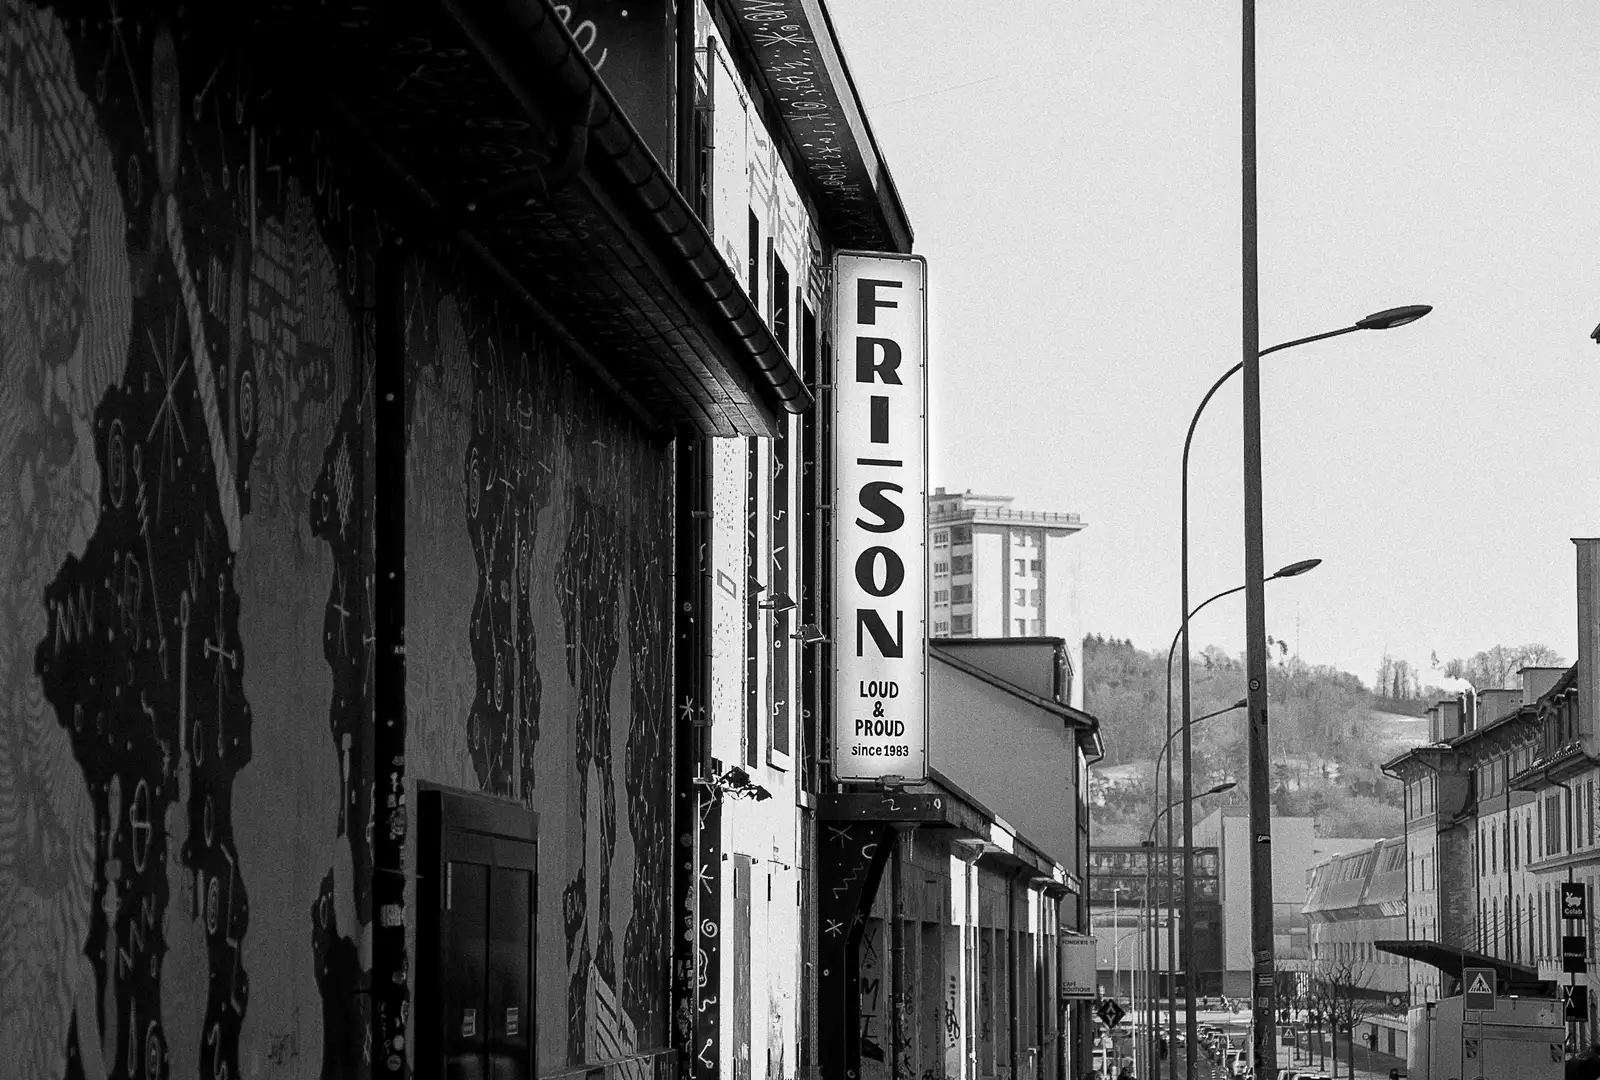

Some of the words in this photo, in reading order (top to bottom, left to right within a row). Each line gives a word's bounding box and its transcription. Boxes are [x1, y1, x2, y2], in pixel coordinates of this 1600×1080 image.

[859, 680, 899, 699] LOUD
[873, 700, 885, 718] &
[855, 719, 905, 737] PROUD
[851, 743, 882, 756] since
[884, 744, 909, 757] 1983
